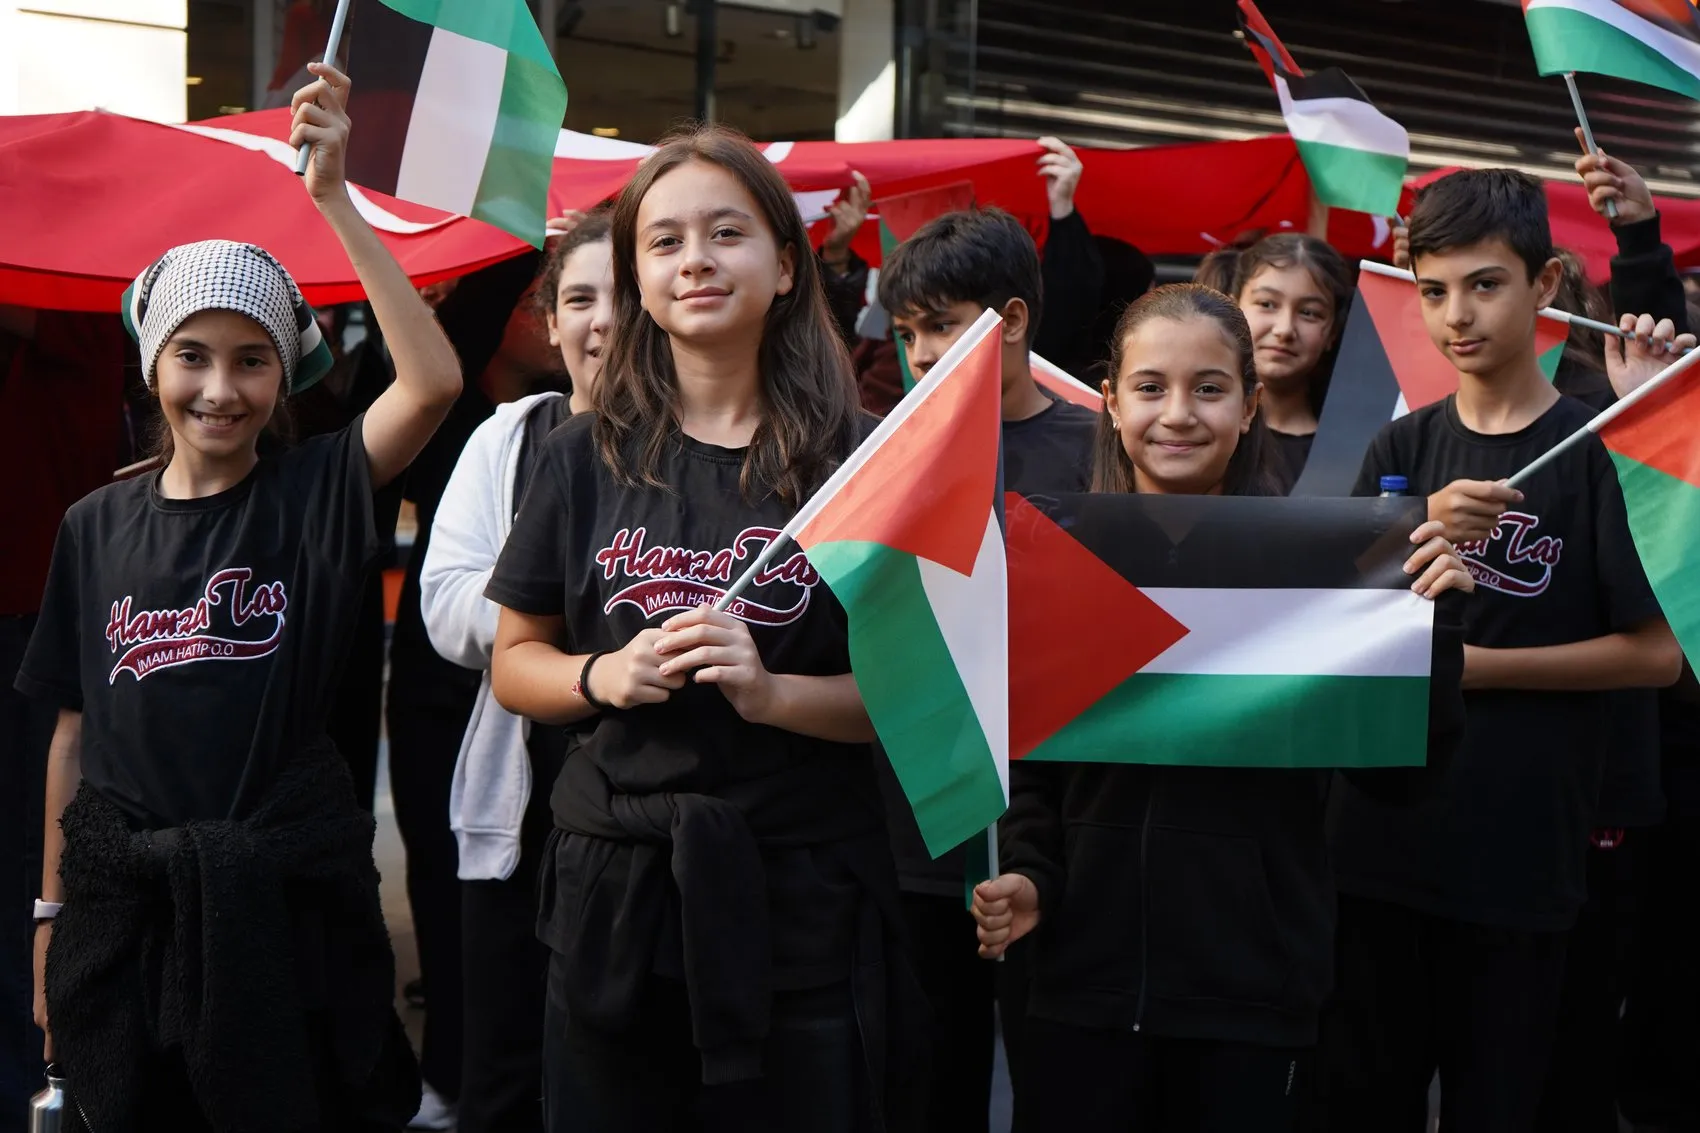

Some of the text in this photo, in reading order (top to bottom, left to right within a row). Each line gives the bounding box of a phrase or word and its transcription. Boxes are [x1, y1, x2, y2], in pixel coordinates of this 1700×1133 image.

[595, 526, 734, 582] Hamza
[1490, 510, 1564, 567] Tas
[105, 567, 288, 653] Hamza Tas
[645, 591, 684, 612] İMAM
